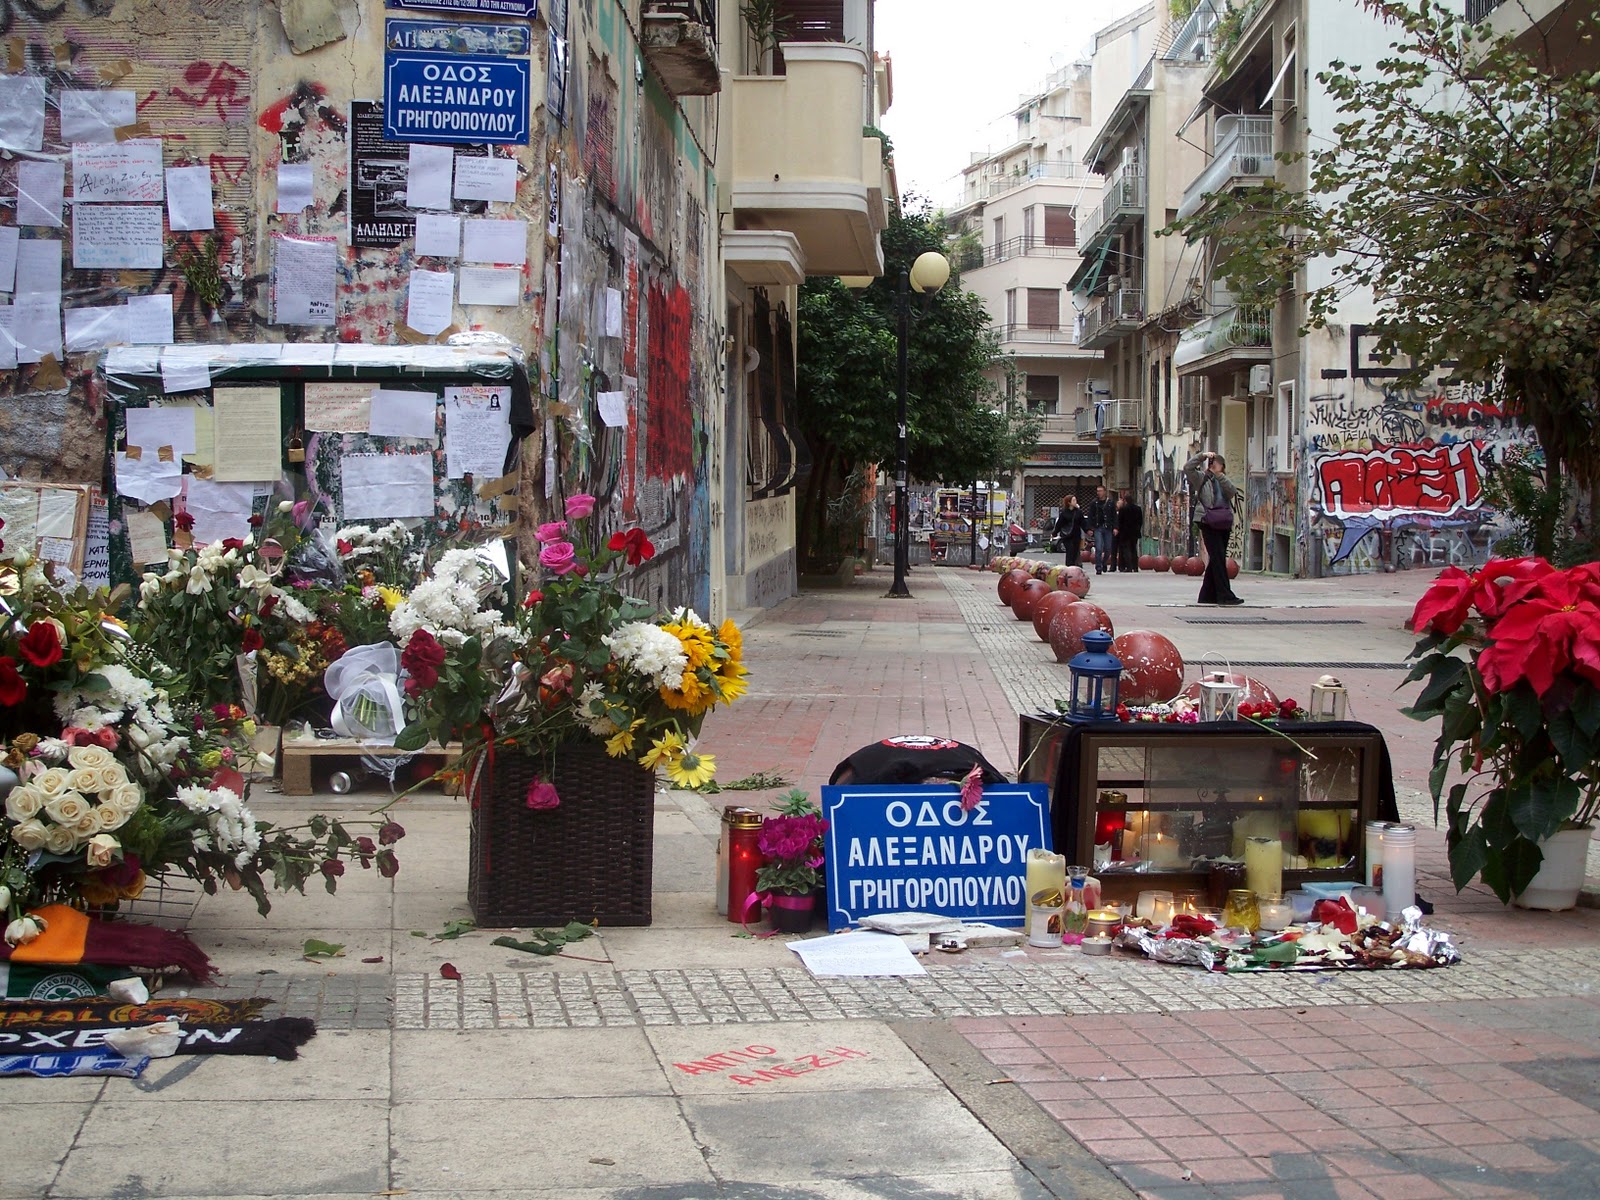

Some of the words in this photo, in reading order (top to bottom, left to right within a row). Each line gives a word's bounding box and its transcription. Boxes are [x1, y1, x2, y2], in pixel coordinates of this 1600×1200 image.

[423, 65, 492, 83] ΟΔΟΣ
[398, 84, 516, 107] ΑΛΕΞΑΝΔΡΟΥ
[398, 109, 516, 132] ΓΡΗΓΟΡΟΠΟΥΛΟΥ
[886, 801, 993, 827] ΟΔΟΣ
[848, 834, 1029, 867] ΑΛΕΞΑΝΔΡΟΥ
